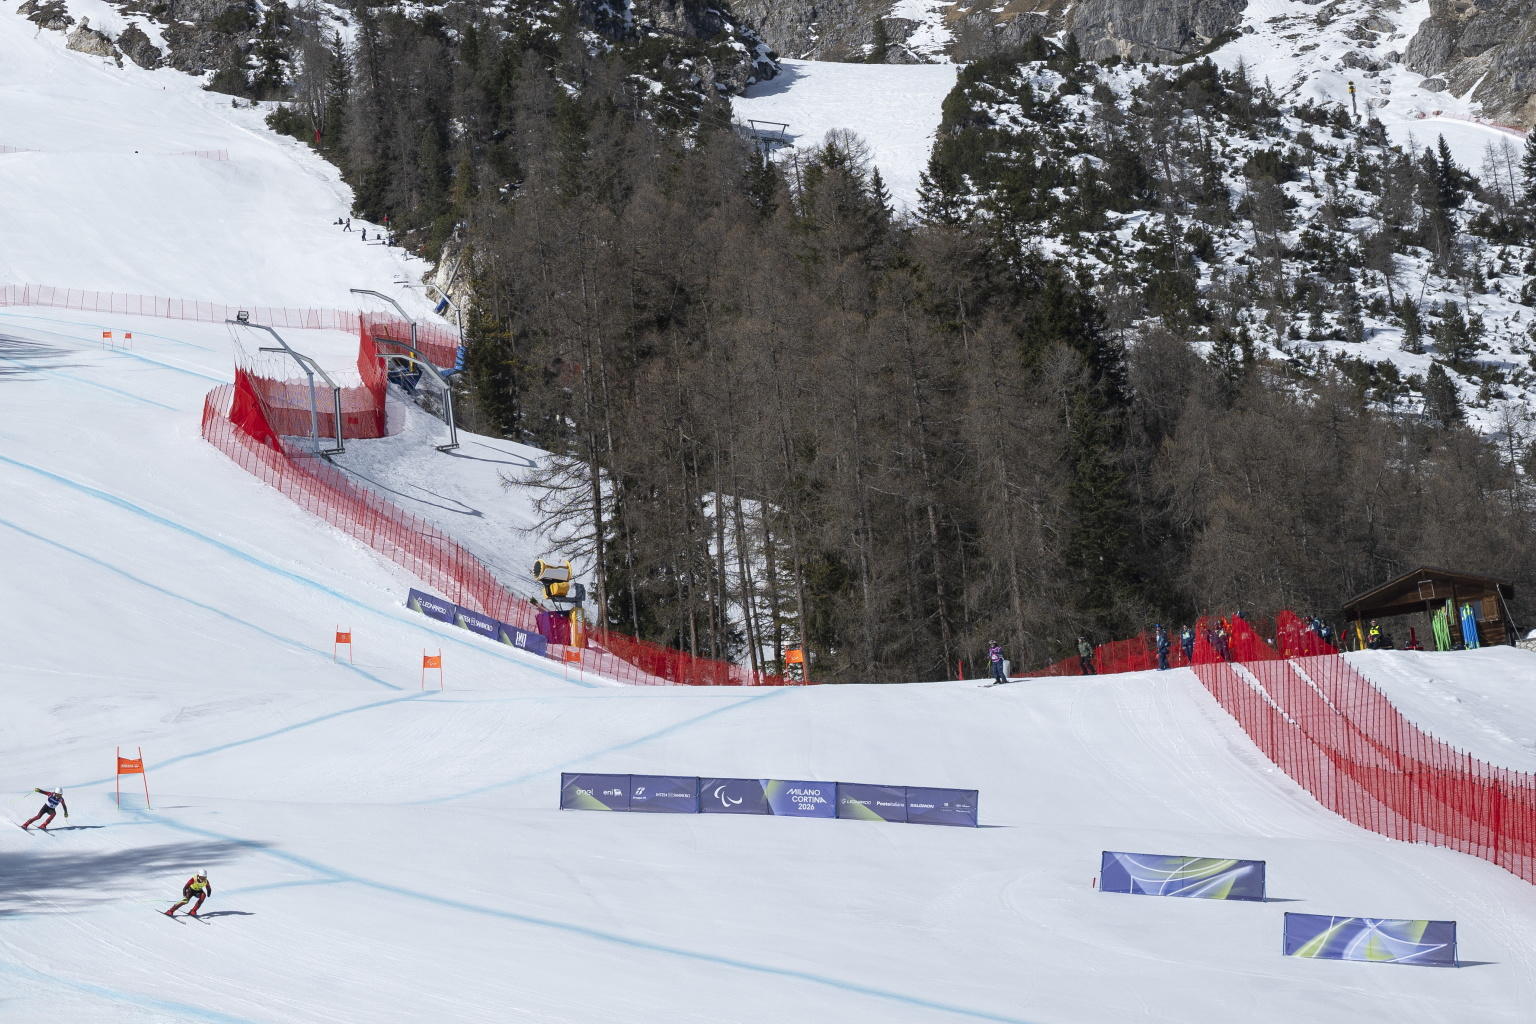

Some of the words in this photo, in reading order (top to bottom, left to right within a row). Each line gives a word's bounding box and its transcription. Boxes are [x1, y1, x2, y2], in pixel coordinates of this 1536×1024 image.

[603, 788, 614, 796] eni
[786, 788, 821, 796] MILANO
[791, 795, 827, 804] CORTINA
